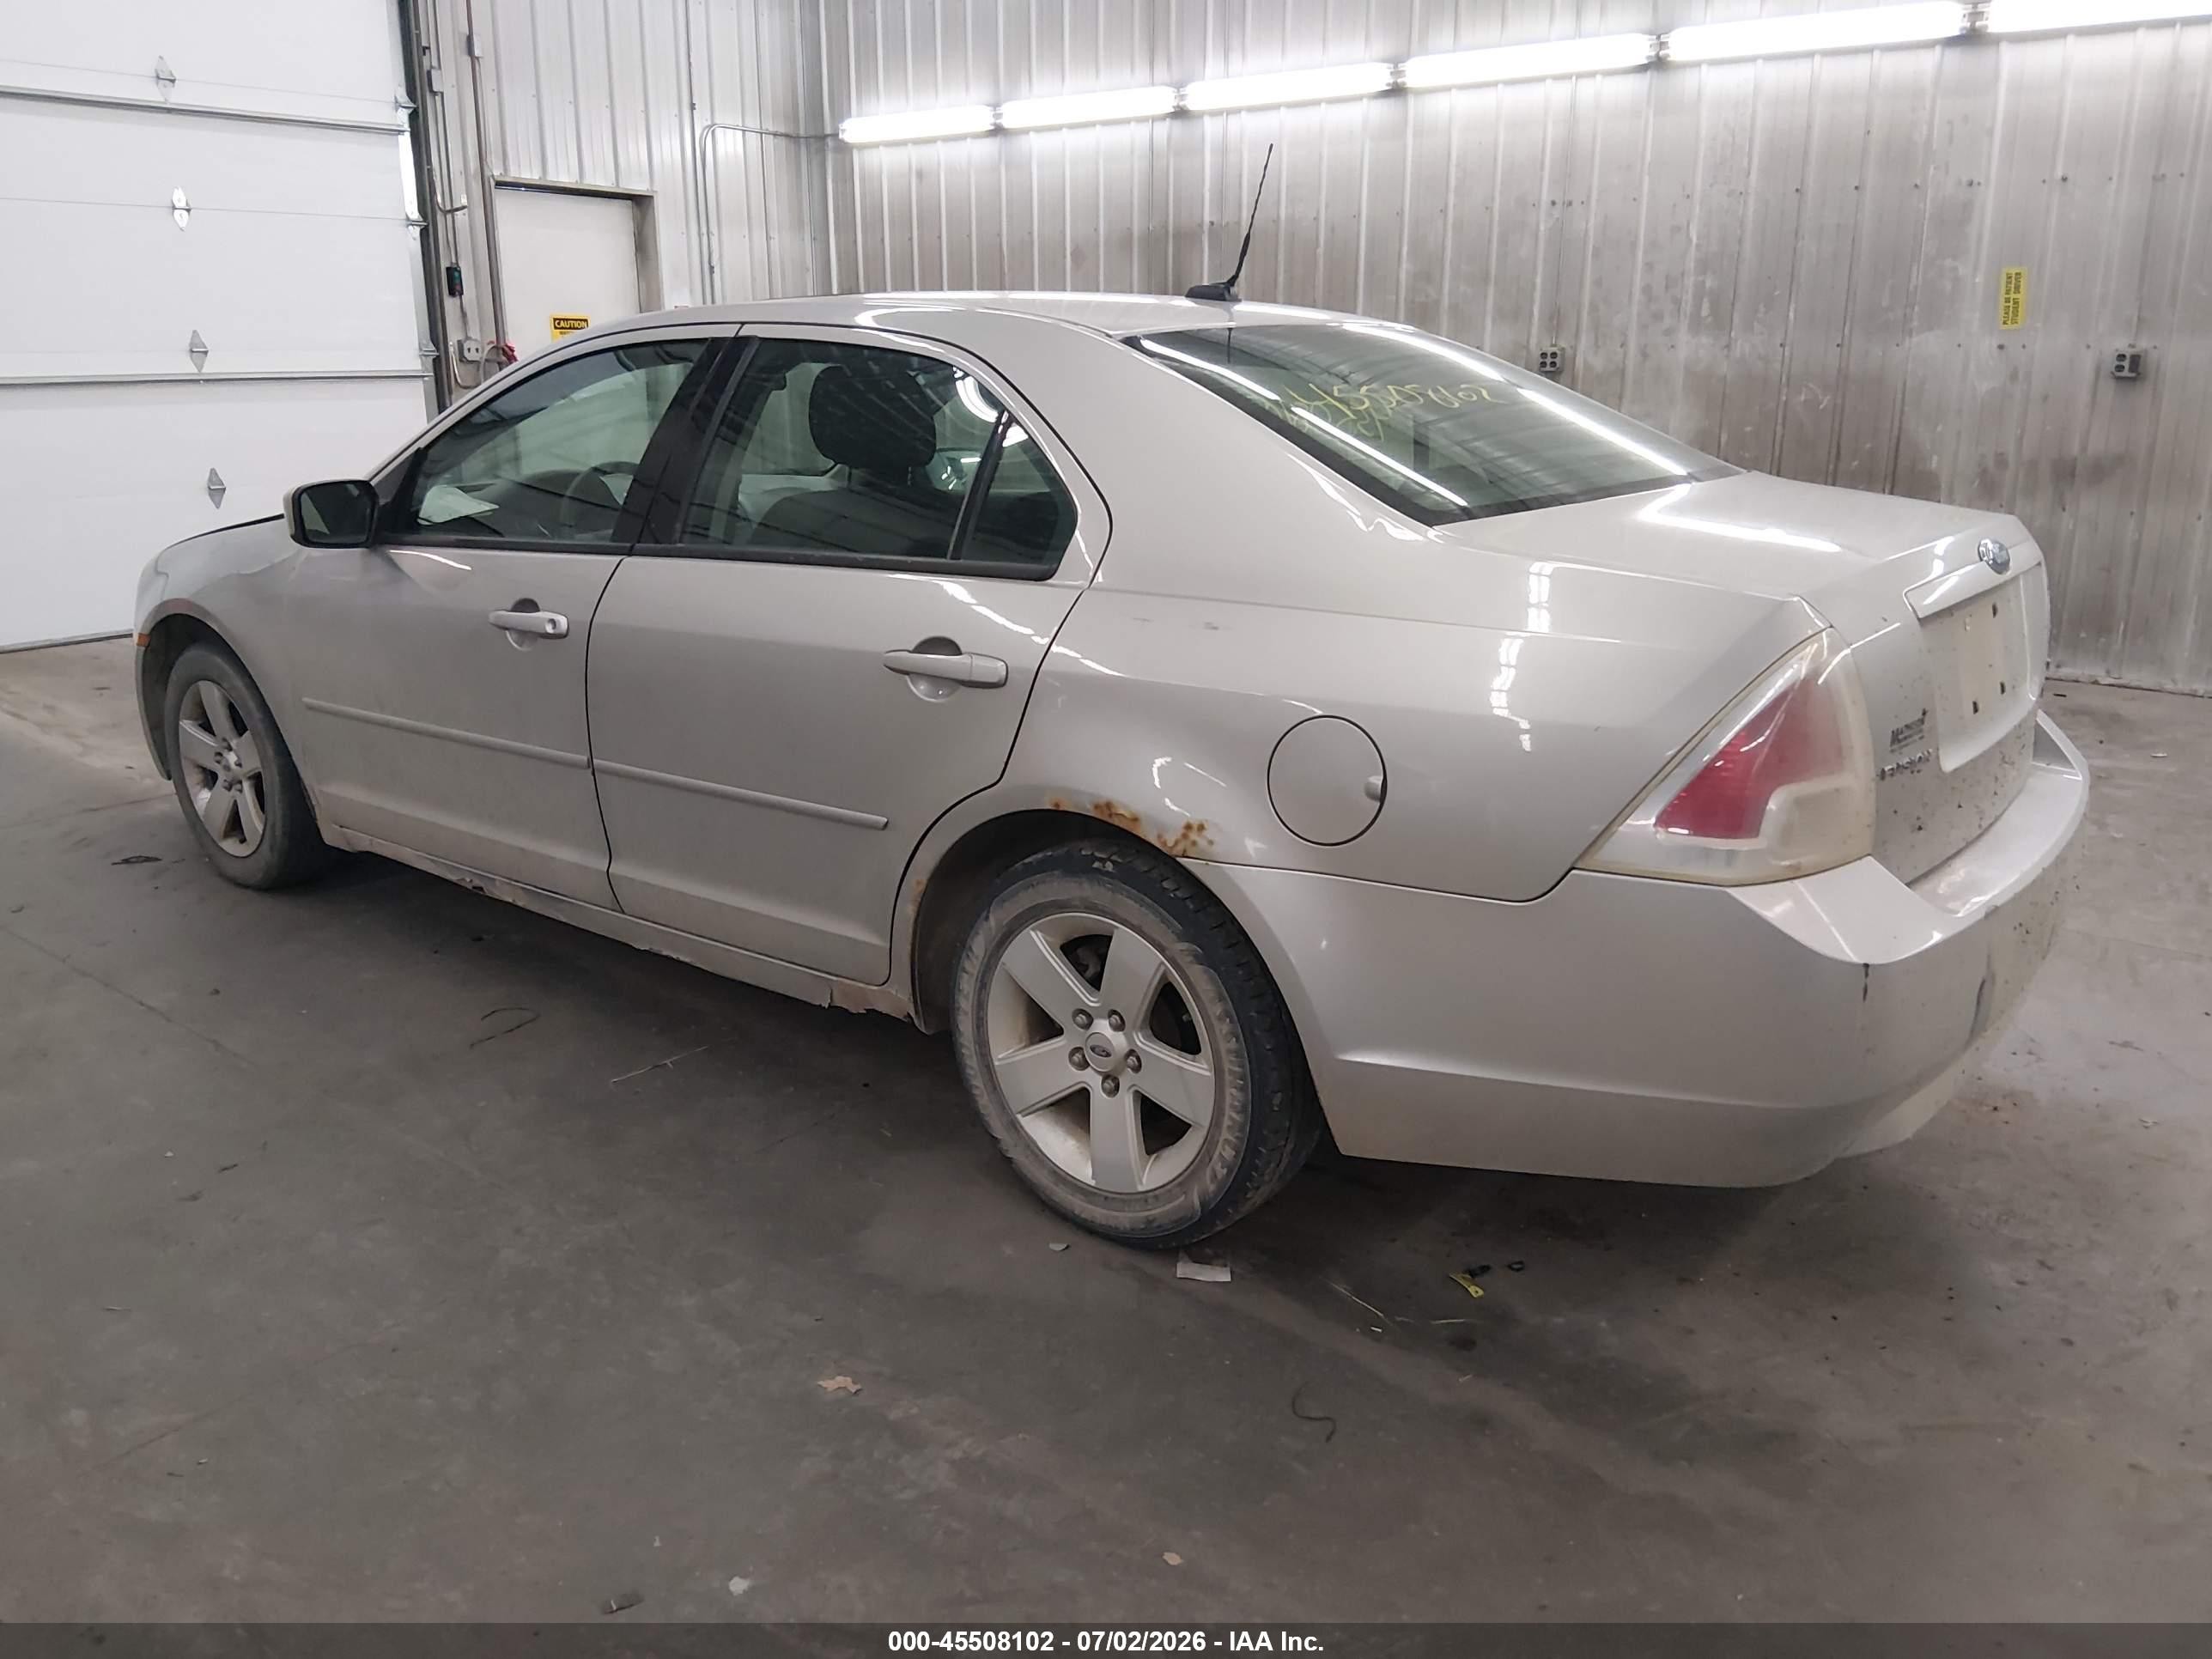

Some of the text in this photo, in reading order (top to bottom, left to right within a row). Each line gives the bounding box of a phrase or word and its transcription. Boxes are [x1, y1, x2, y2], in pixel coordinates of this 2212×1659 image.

[2005, 272, 2014, 295] PATIENT
[2010, 271, 2022, 325] STUDENT DRIVER
[555, 319, 587, 328] CAUTION
